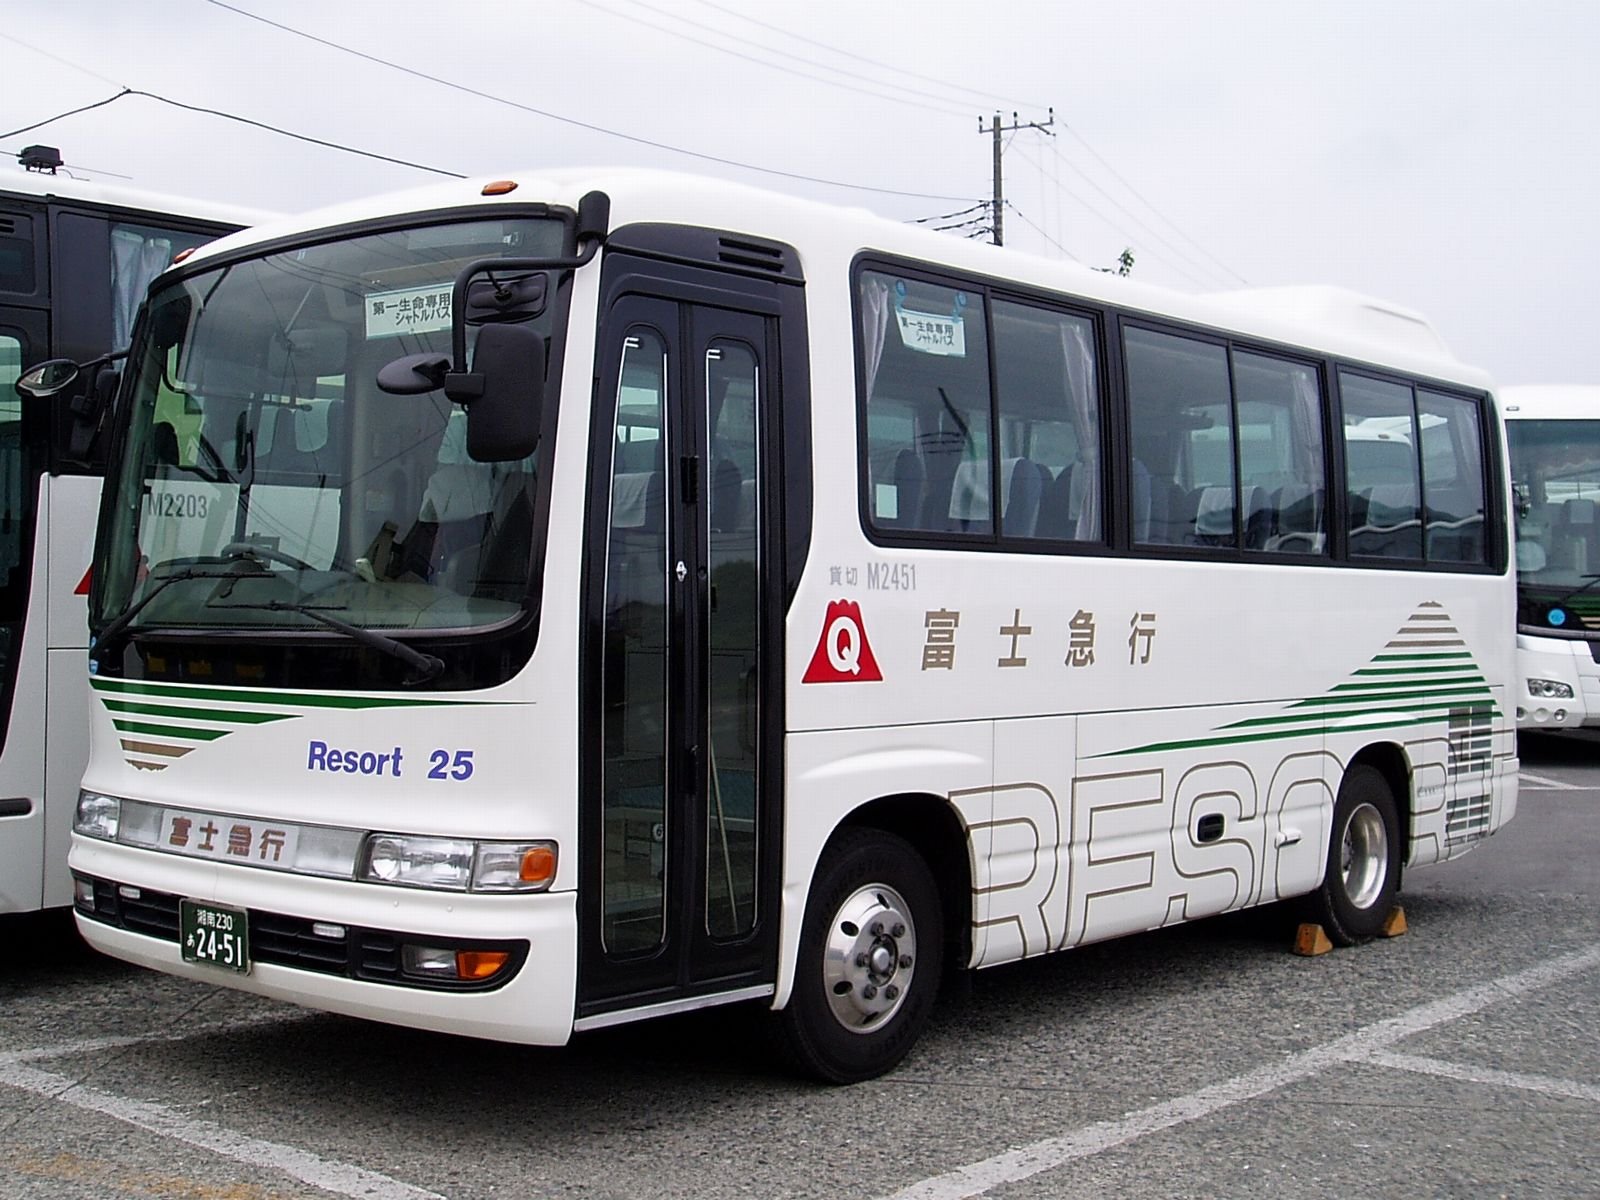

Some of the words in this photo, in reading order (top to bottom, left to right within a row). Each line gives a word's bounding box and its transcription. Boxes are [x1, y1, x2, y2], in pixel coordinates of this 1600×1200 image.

[373, 292, 451, 316] 第一生命専用
[395, 306, 451, 326] シャトルバス
[148, 492, 207, 518] M2203
[867, 562, 916, 590] M2451
[921, 607, 1157, 671] 富士急行
[307, 740, 403, 777] Resort
[427, 749, 474, 781] 25
[169, 816, 286, 861] 富士急行
[196, 928, 242, 967] 24-51
